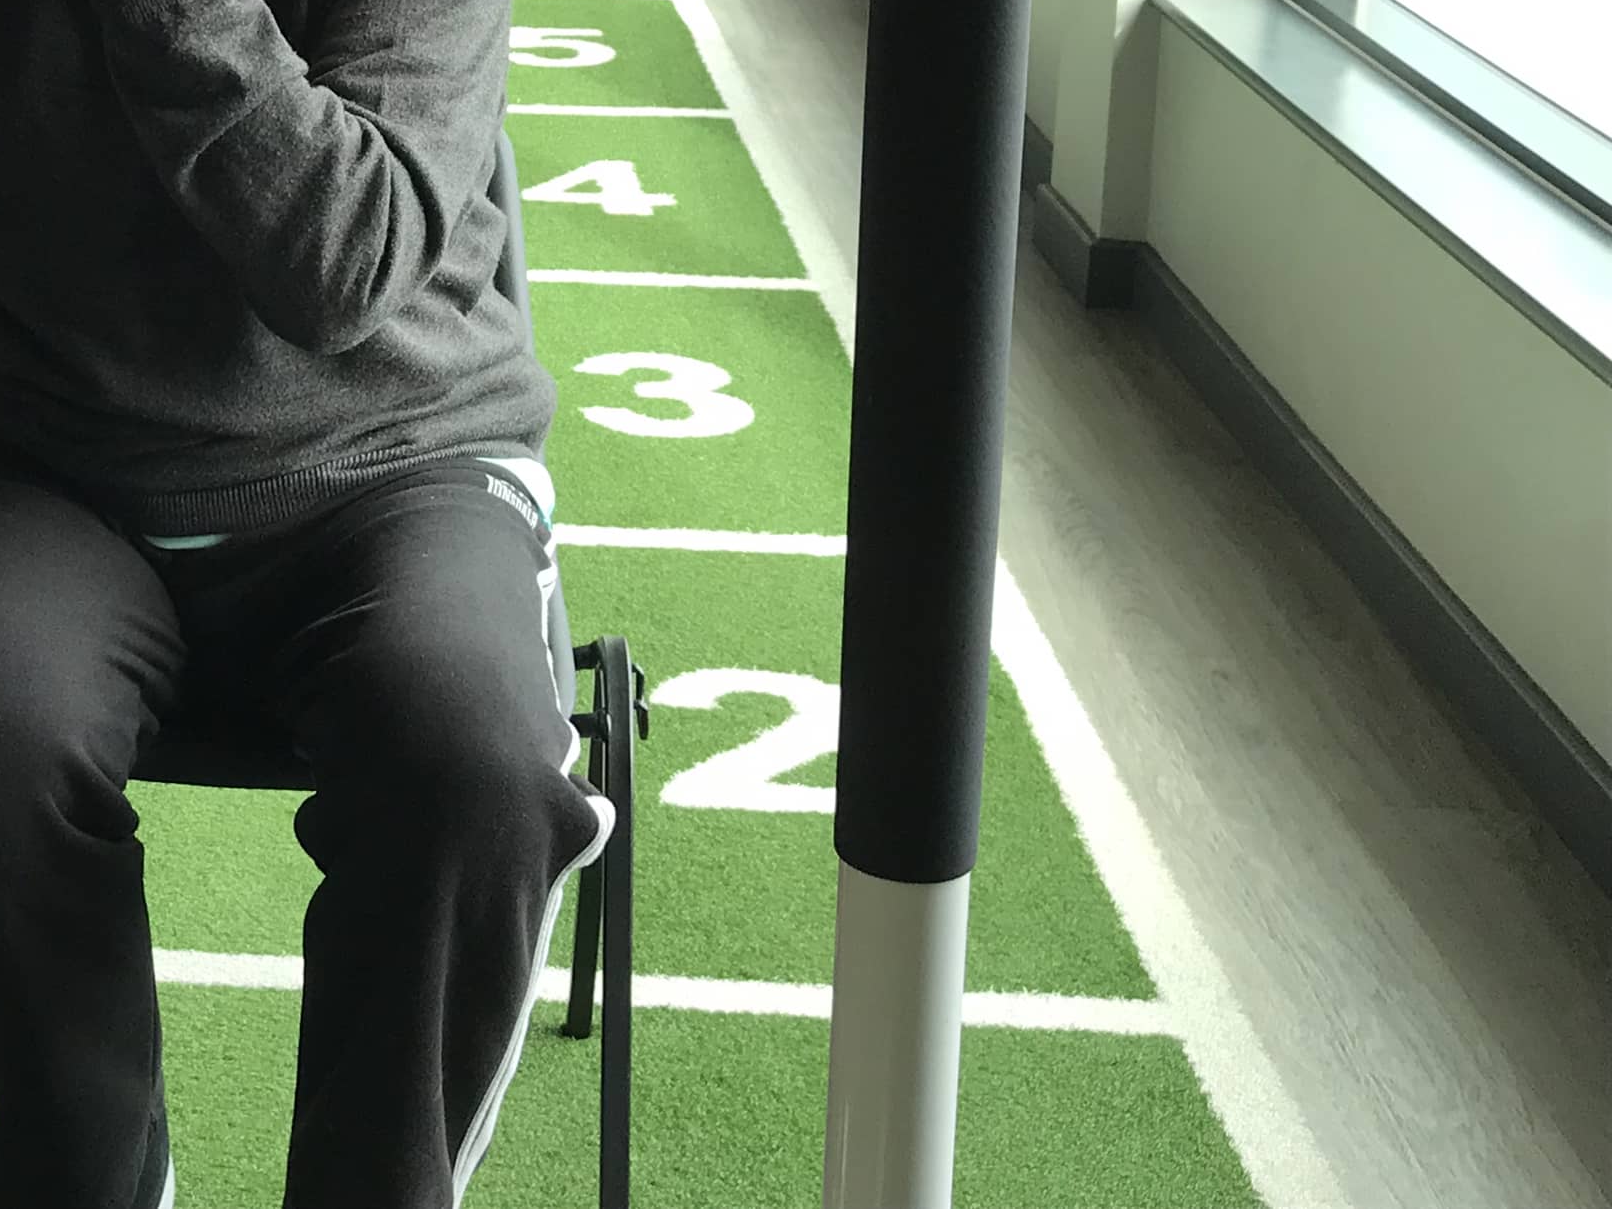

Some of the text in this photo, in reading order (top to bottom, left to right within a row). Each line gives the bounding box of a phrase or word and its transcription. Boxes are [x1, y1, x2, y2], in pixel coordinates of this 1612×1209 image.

[508, 27, 617, 68] 5
[521, 159, 678, 216] 4
[571, 351, 756, 439] 3
[649, 667, 842, 815] 2
